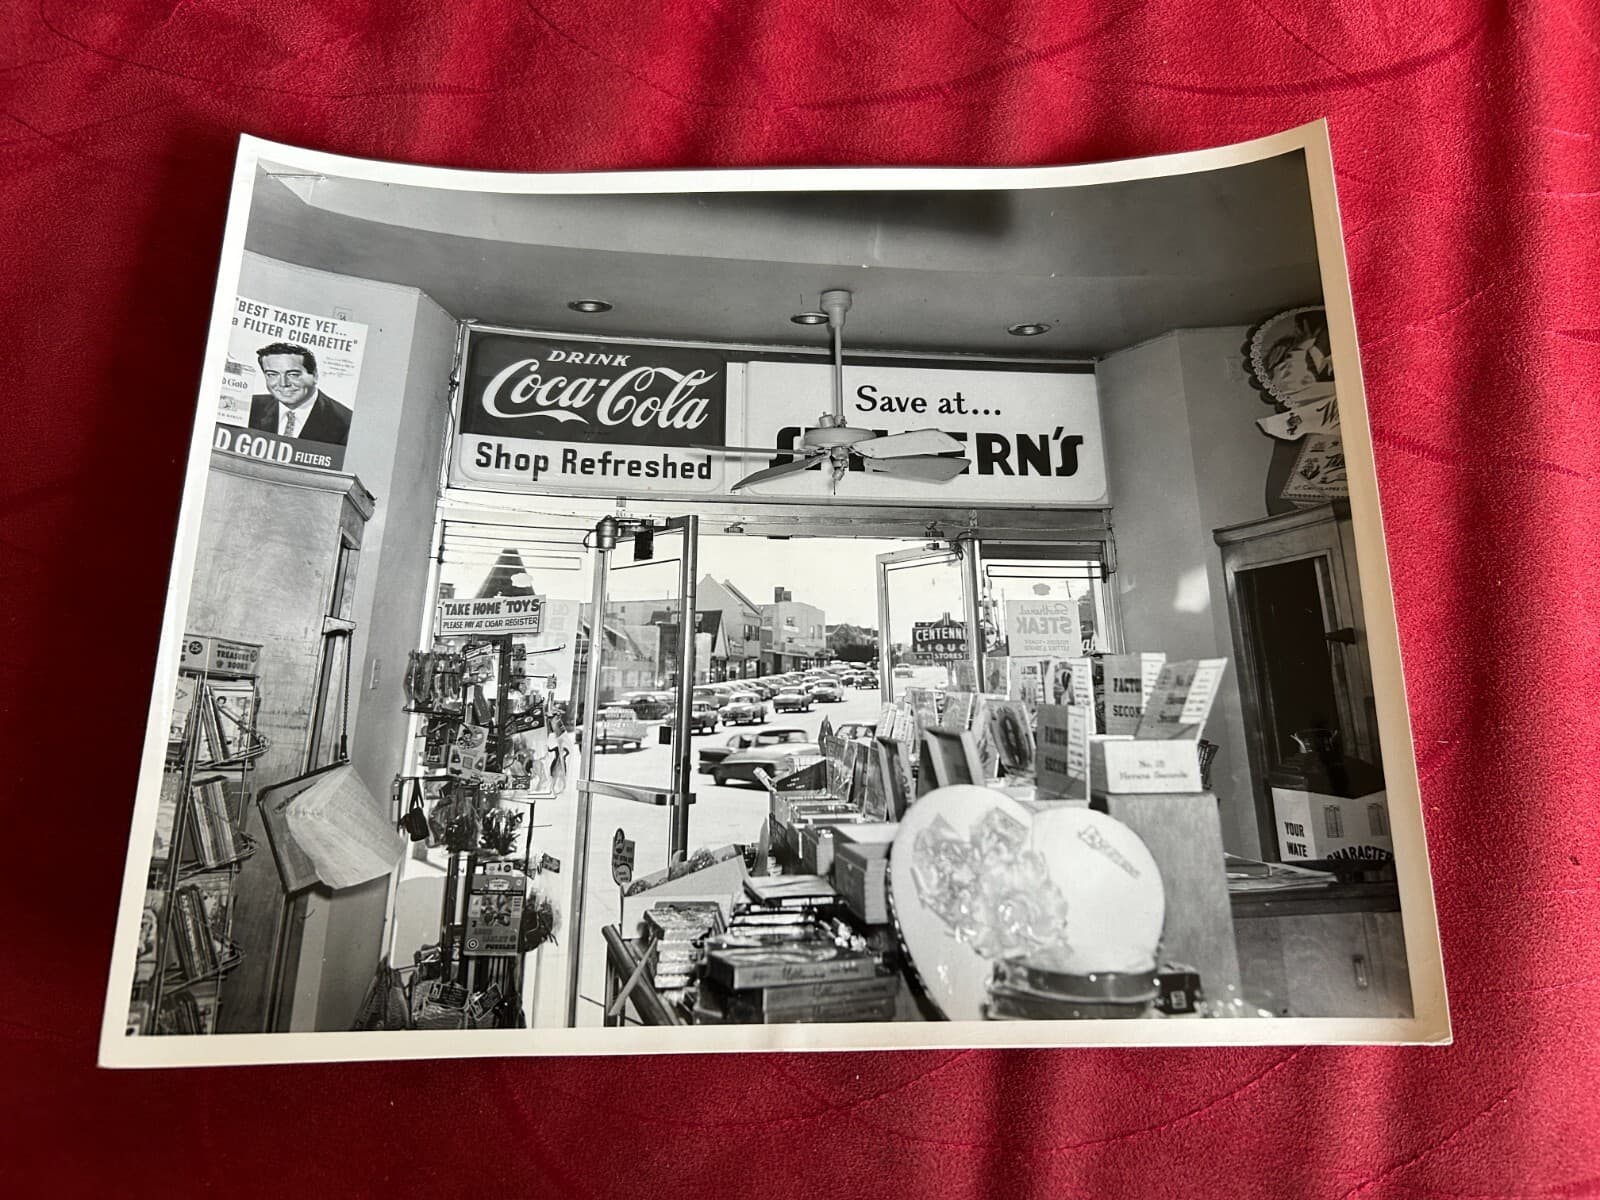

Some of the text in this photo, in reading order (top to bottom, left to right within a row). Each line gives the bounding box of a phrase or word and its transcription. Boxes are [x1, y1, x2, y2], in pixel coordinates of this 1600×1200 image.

[243, 318, 283, 338] FILTER
[288, 329, 358, 352] CIGARETTE"
[274, 310, 310, 329] TASTE
[316, 320, 347, 336] YET...
[547, 350, 632, 367] DRINK
[481, 358, 718, 430] Coca-Cola
[855, 385, 1001, 416] Save at...
[235, 433, 293, 464] GOLD
[295, 451, 332, 467] FILTERS
[475, 442, 712, 481] Shop Refreshed
[443, 620, 463, 629] PLEASE
[475, 620, 484, 628] AT
[504, 616, 538, 626] REGISTER
[1284, 821, 1305, 838] YOUR
[1286, 841, 1308, 858] WATE
